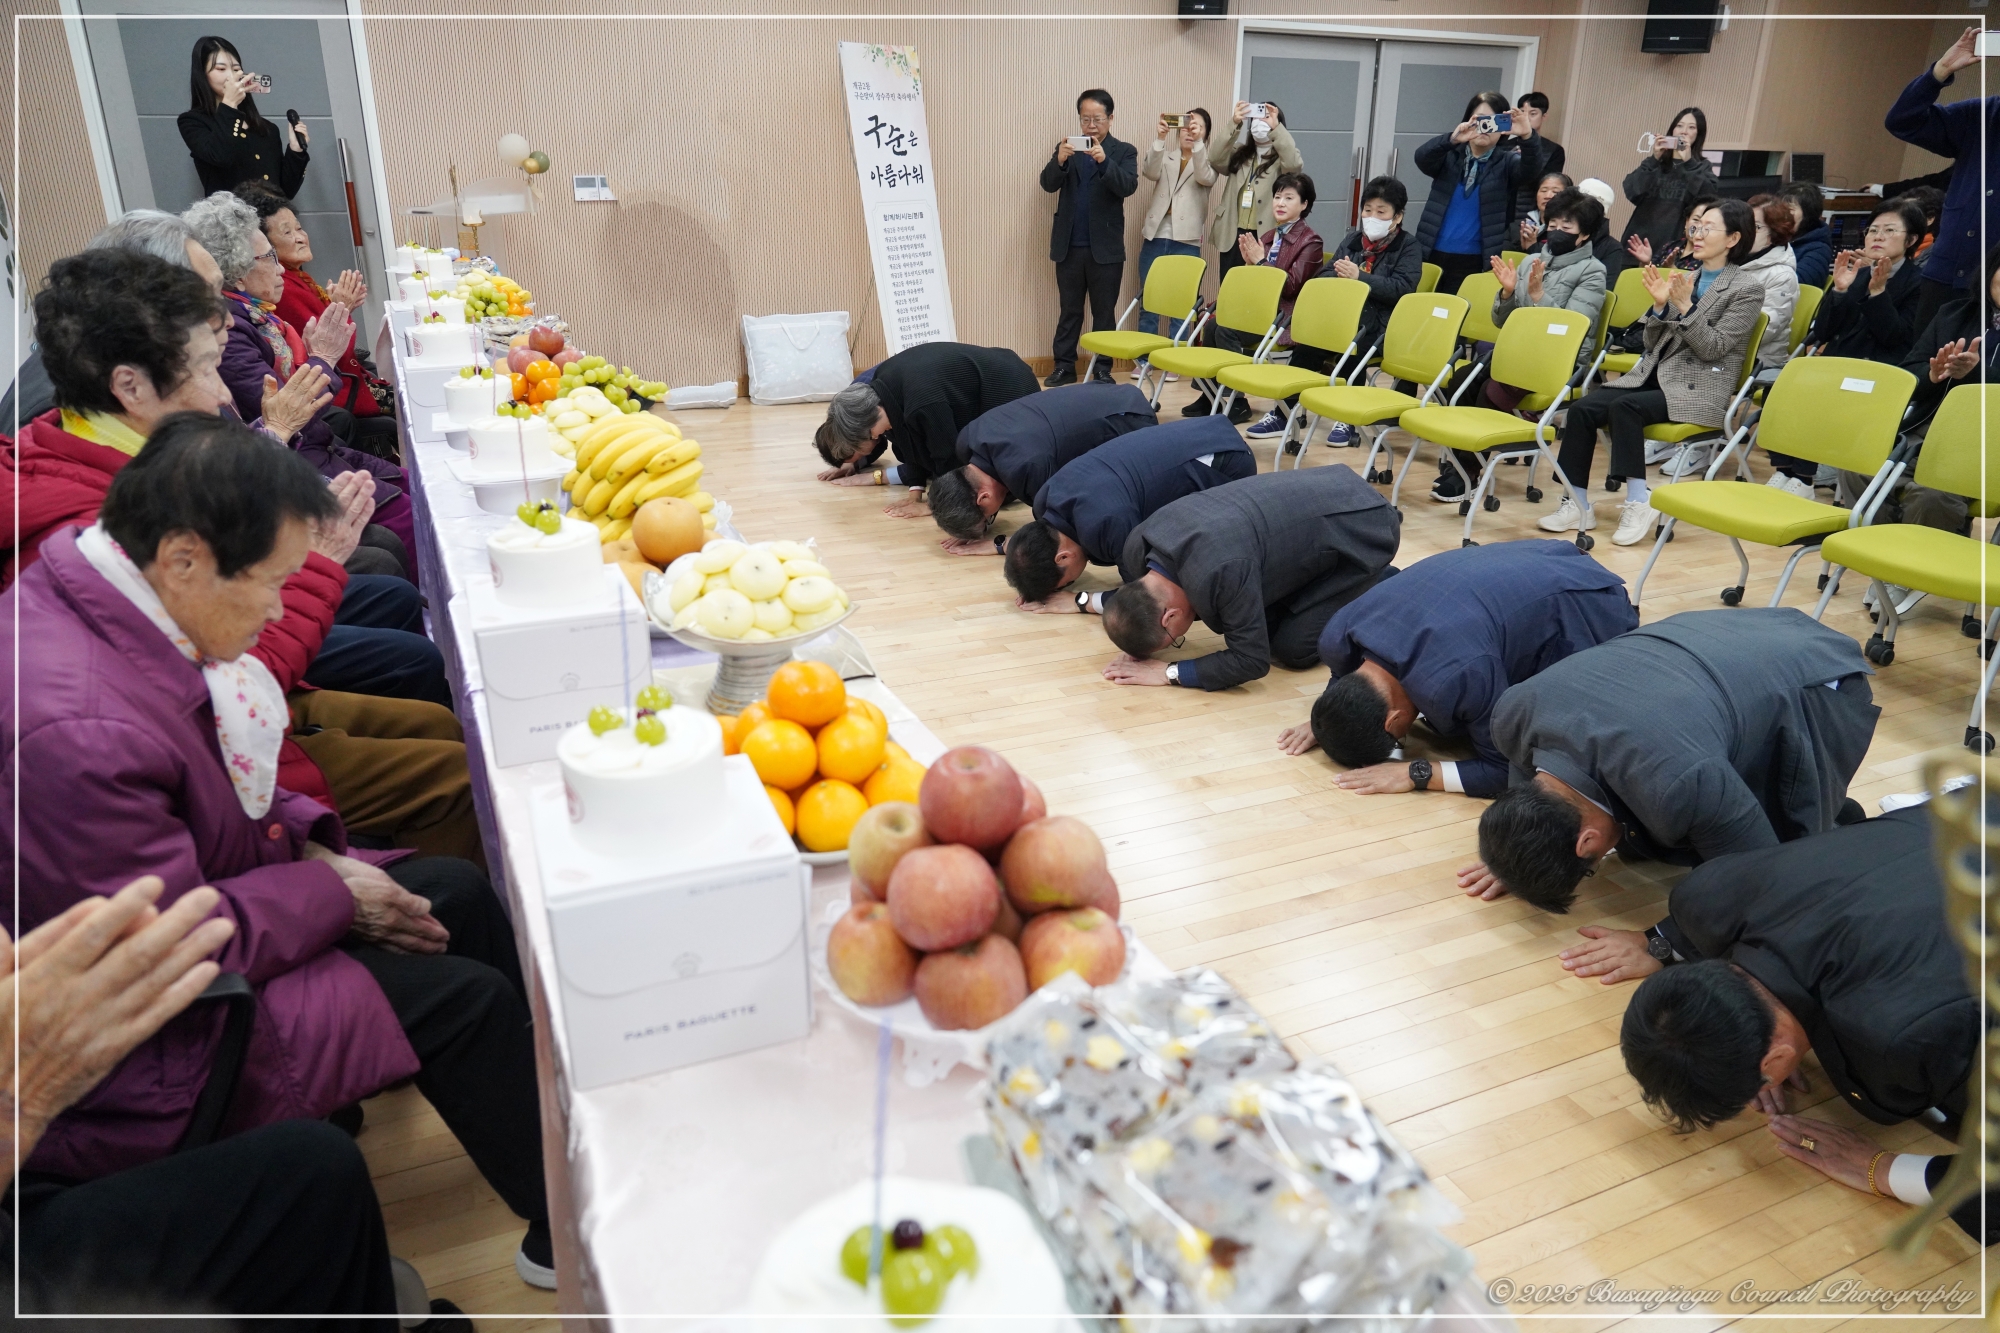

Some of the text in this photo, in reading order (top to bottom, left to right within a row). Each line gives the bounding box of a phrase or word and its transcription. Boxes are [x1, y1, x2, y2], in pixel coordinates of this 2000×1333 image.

[852, 82, 871, 91] 개금2동
[854, 92, 875, 100] 구순맞이
[875, 92, 896, 101] 장수주민
[870, 164, 924, 188] 아름다워
[624, 1004, 757, 1041] PARIS BAGUETTE
